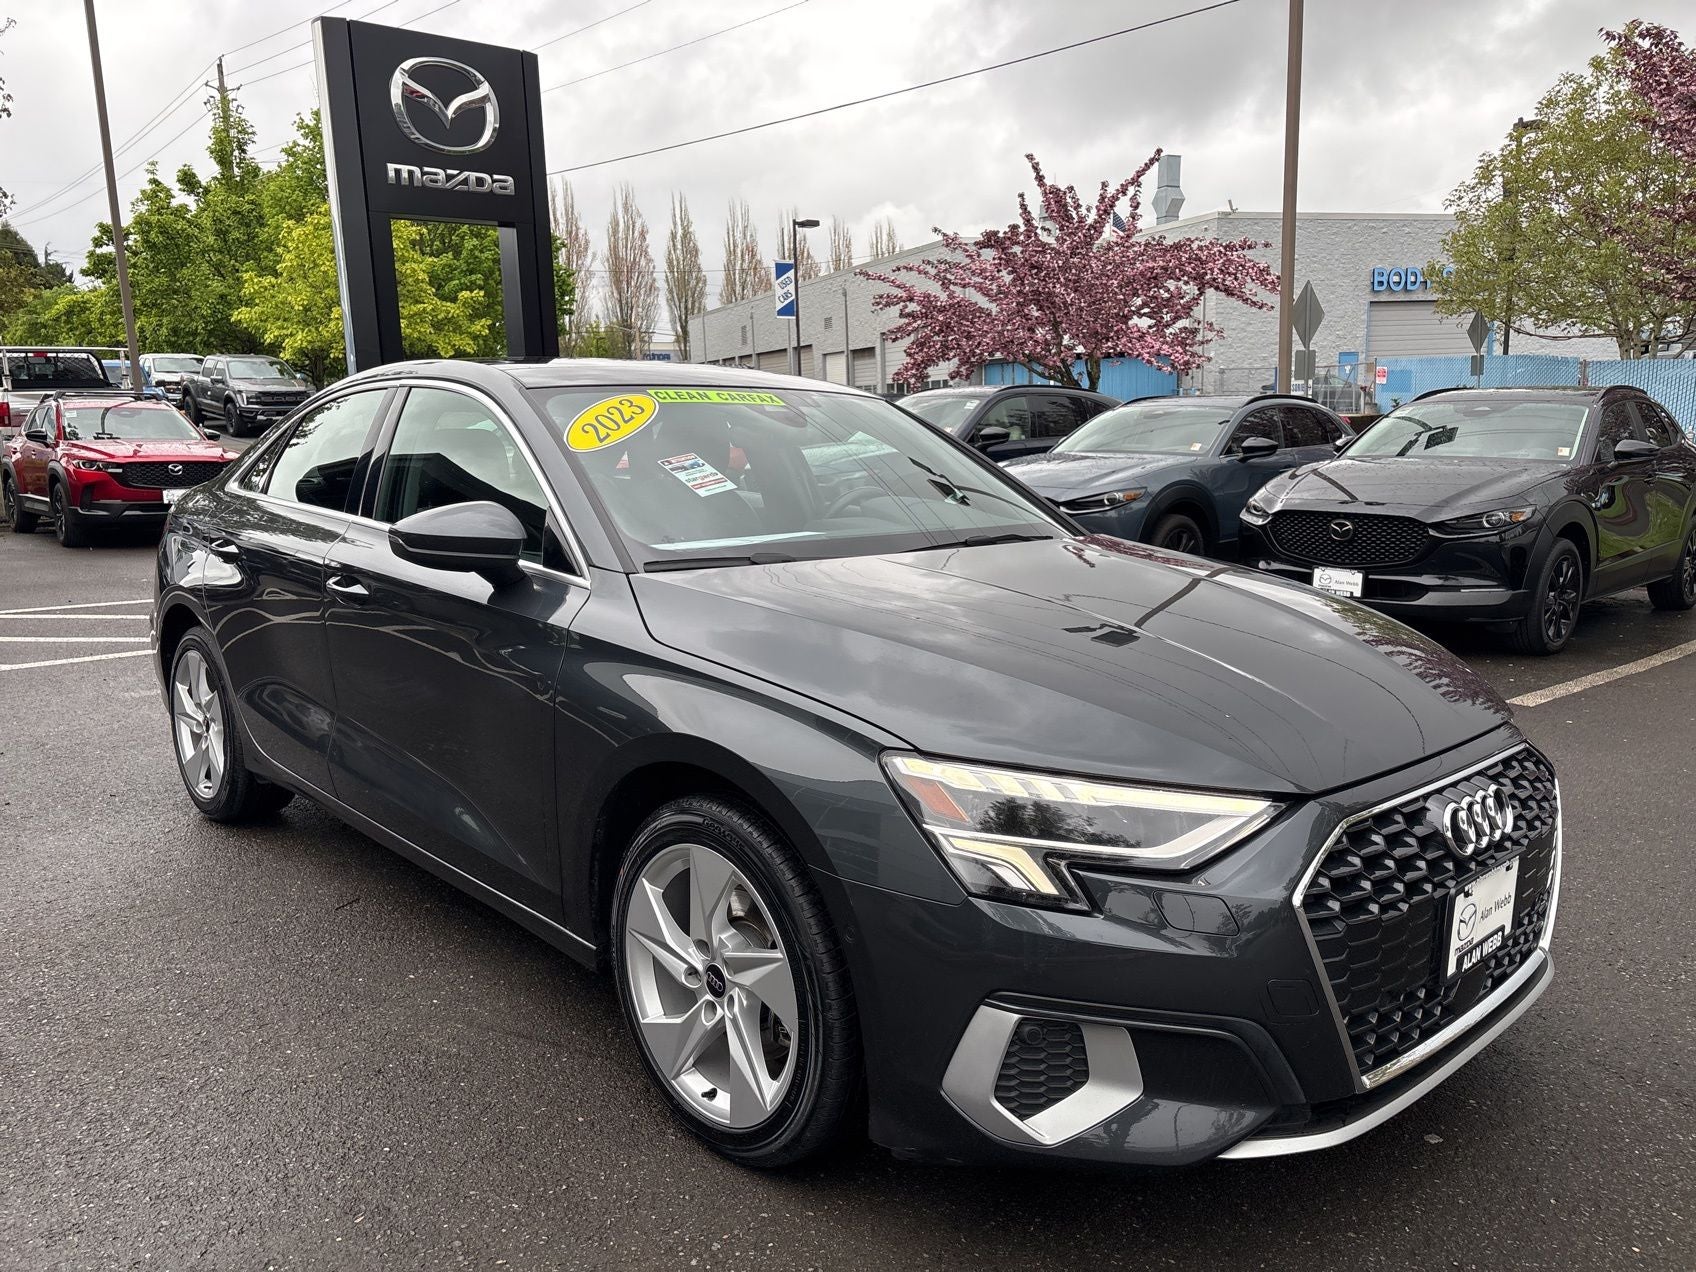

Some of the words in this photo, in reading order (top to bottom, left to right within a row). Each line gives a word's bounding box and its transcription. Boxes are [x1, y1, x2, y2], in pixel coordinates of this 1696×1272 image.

[778, 276, 793, 290] USED
[778, 289, 793, 303] CARS
[654, 390, 711, 401] CLEAN
[717, 392, 779, 404] CARFAX
[581, 398, 646, 444] 2023
[1480, 907, 1493, 921] Alan
[1494, 893, 1511, 911] Webb
[1462, 945, 1481, 972] ALAN
[1482, 931, 1502, 957] WEBB
